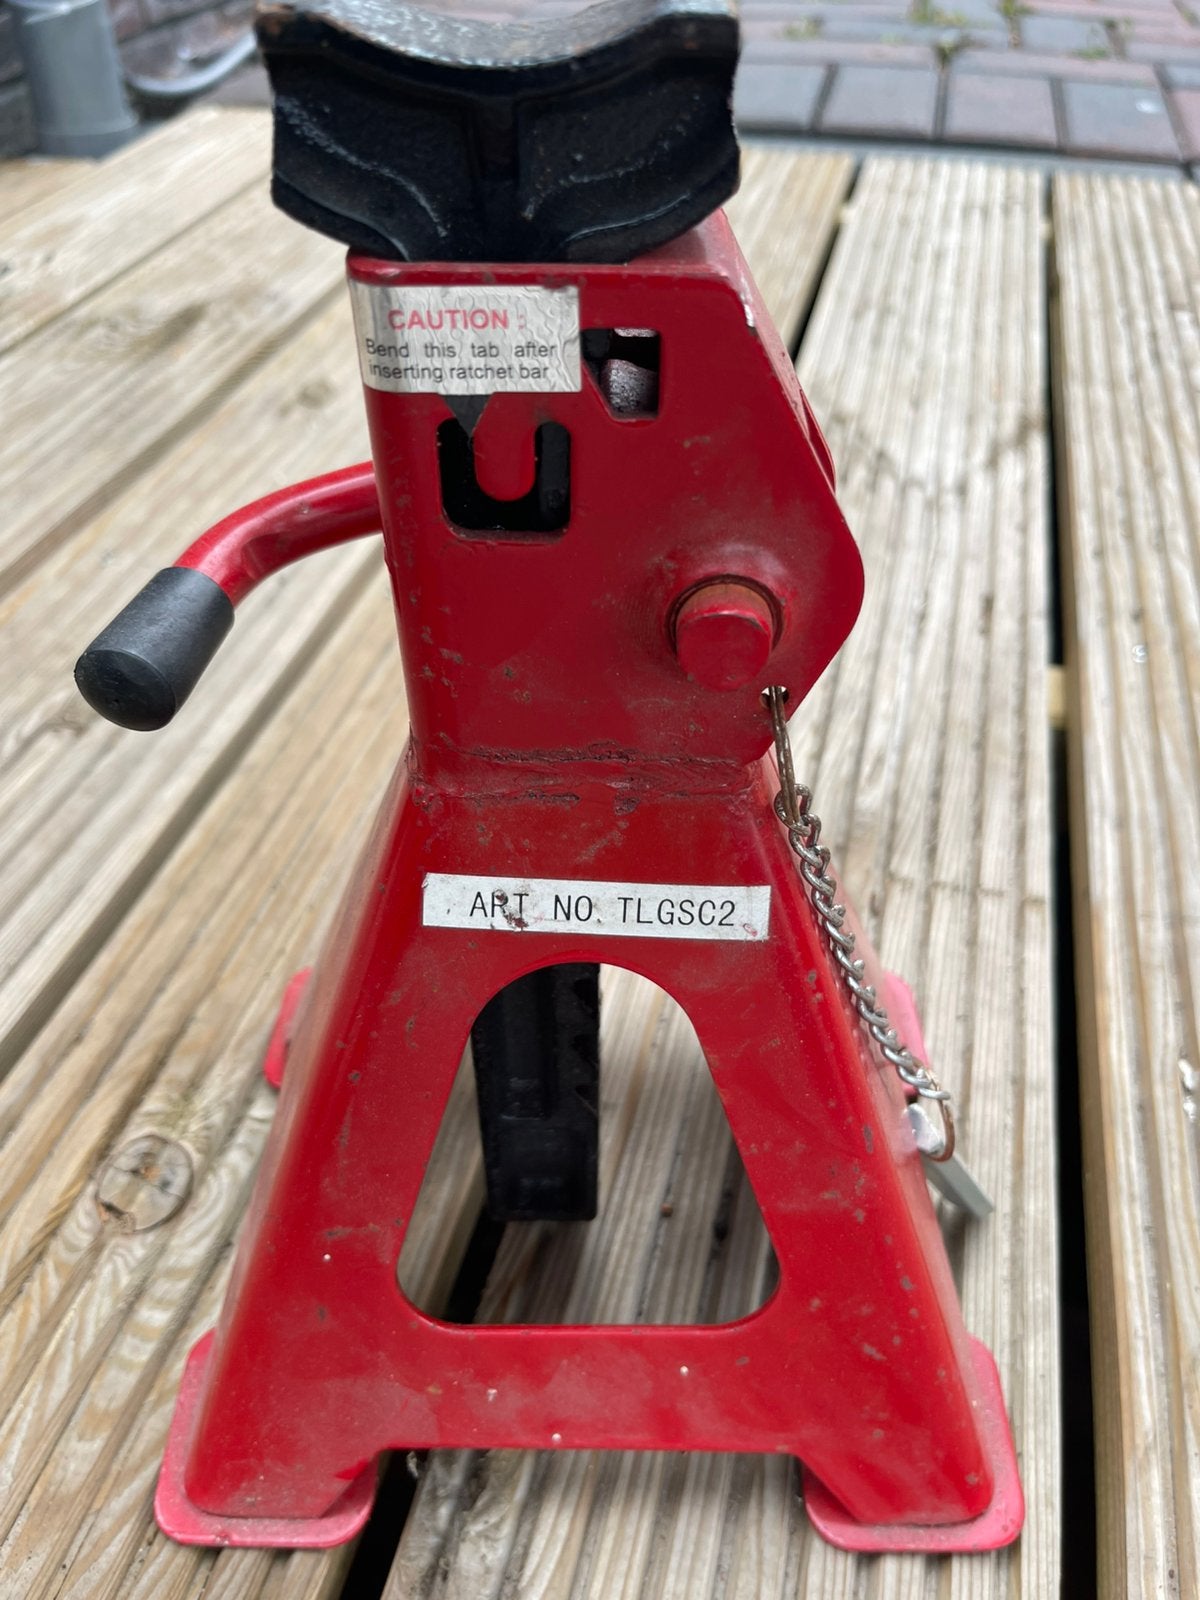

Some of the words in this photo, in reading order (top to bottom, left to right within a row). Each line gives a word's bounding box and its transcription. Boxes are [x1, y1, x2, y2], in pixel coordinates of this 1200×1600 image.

[387, 310, 508, 330] CAUTION
[367, 338, 409, 357] Bend
[424, 341, 456, 357] this
[471, 341, 499, 357] tab
[514, 341, 557, 357] after
[368, 360, 443, 382] inserting
[449, 363, 514, 379] ratchet
[520, 363, 550, 379] bar
[469, 891, 530, 918] ART
[617, 897, 736, 927] TLGSC2
